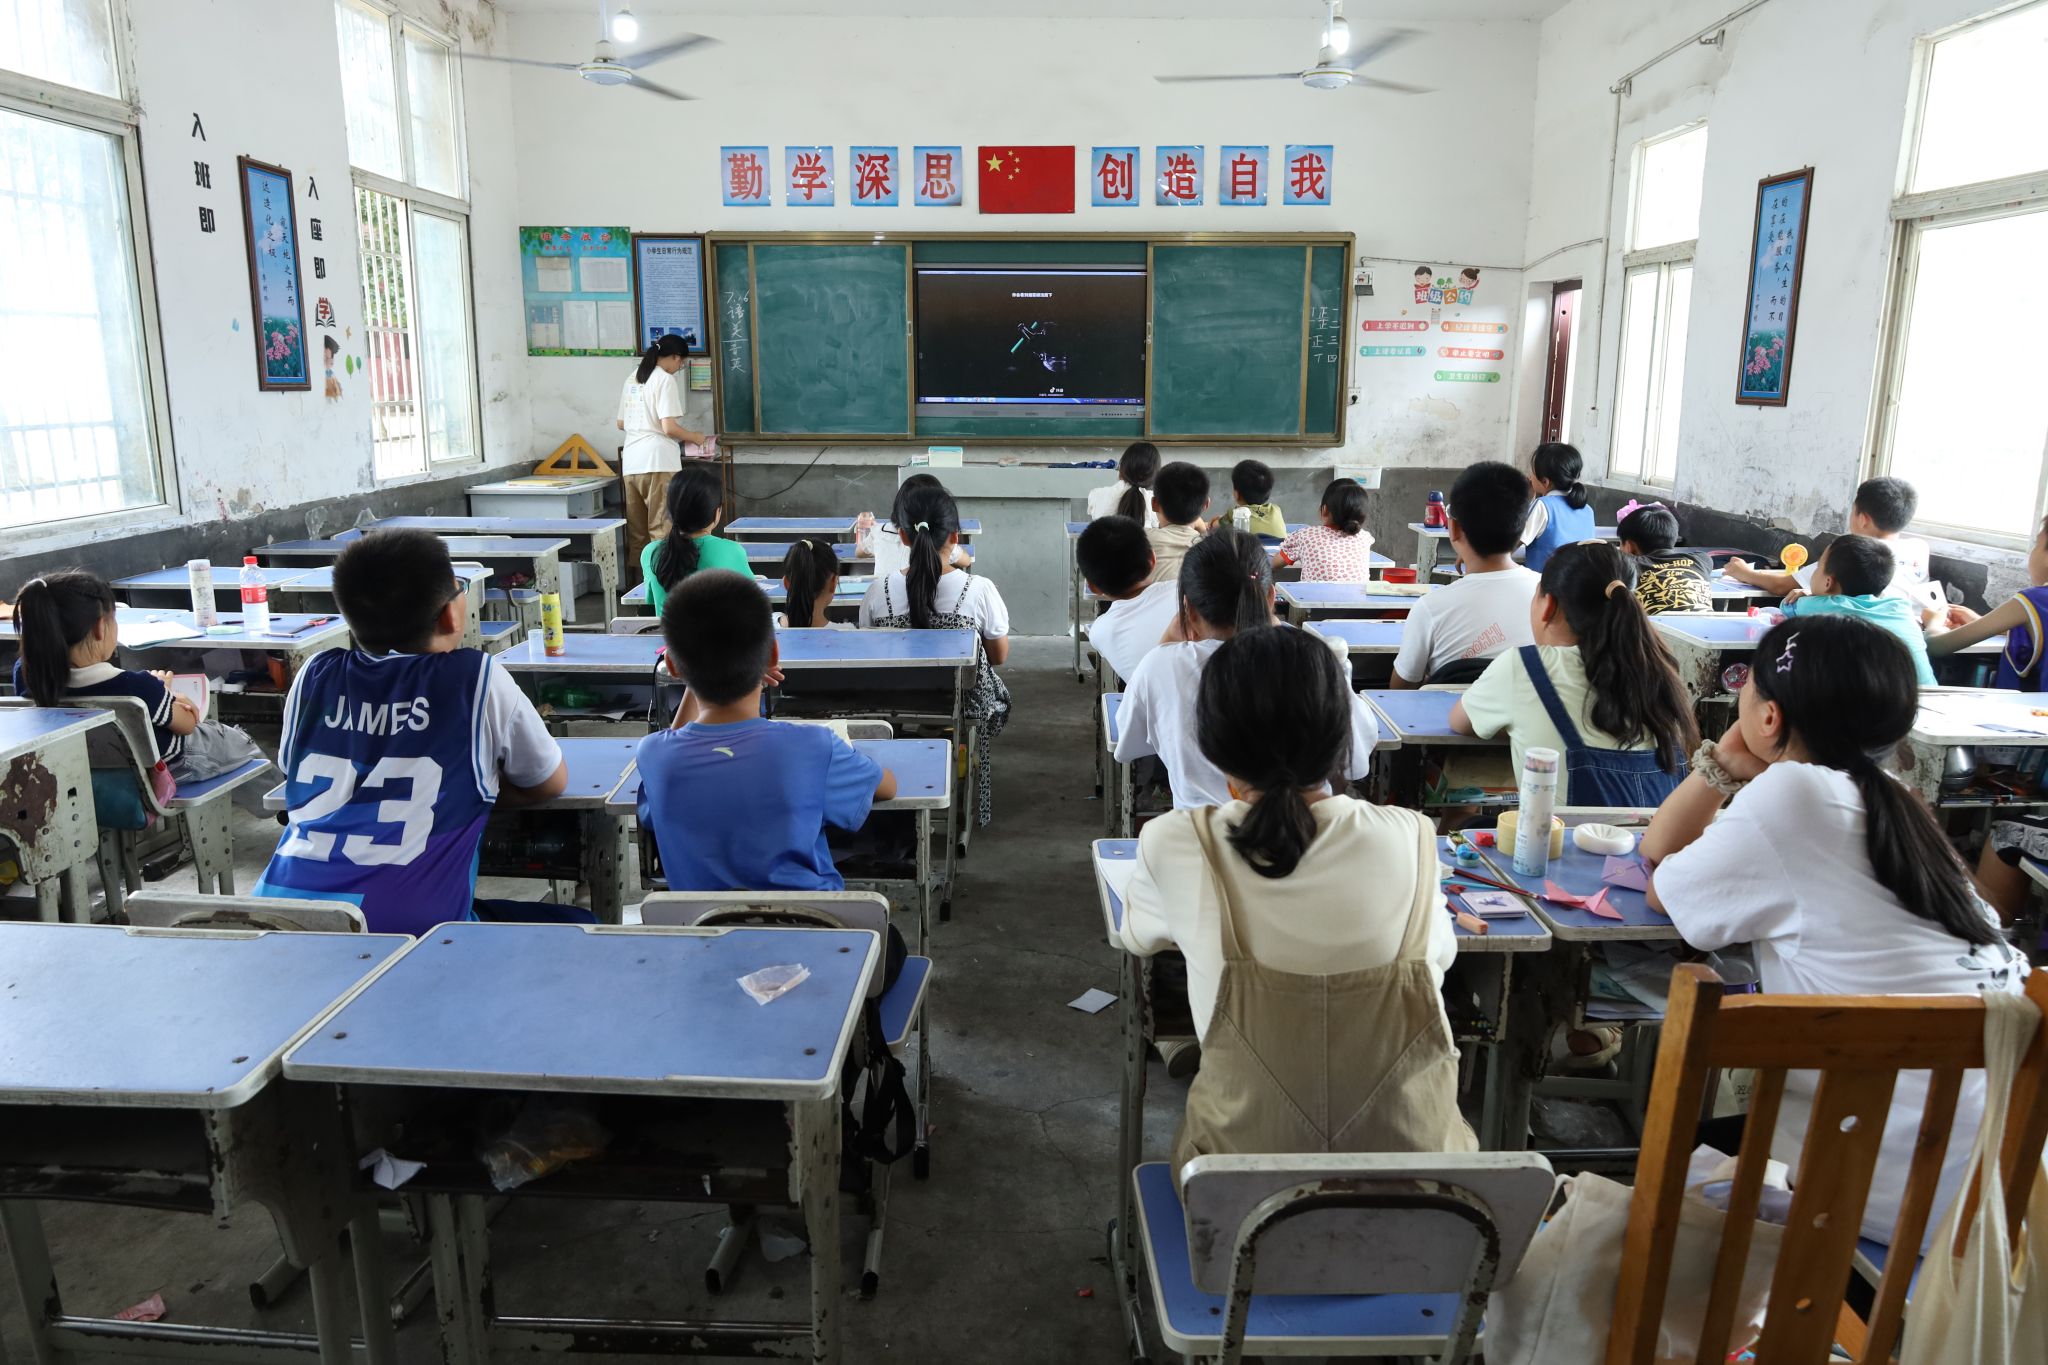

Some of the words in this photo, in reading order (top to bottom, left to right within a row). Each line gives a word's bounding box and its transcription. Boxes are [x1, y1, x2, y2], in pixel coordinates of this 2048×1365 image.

[727, 151, 957, 201] 勤学深思
[1097, 151, 1325, 201] 创造自我
[307, 175, 332, 320] 入座即学
[1416, 289, 1472, 303] 班级公约
[276, 752, 443, 866] 23
